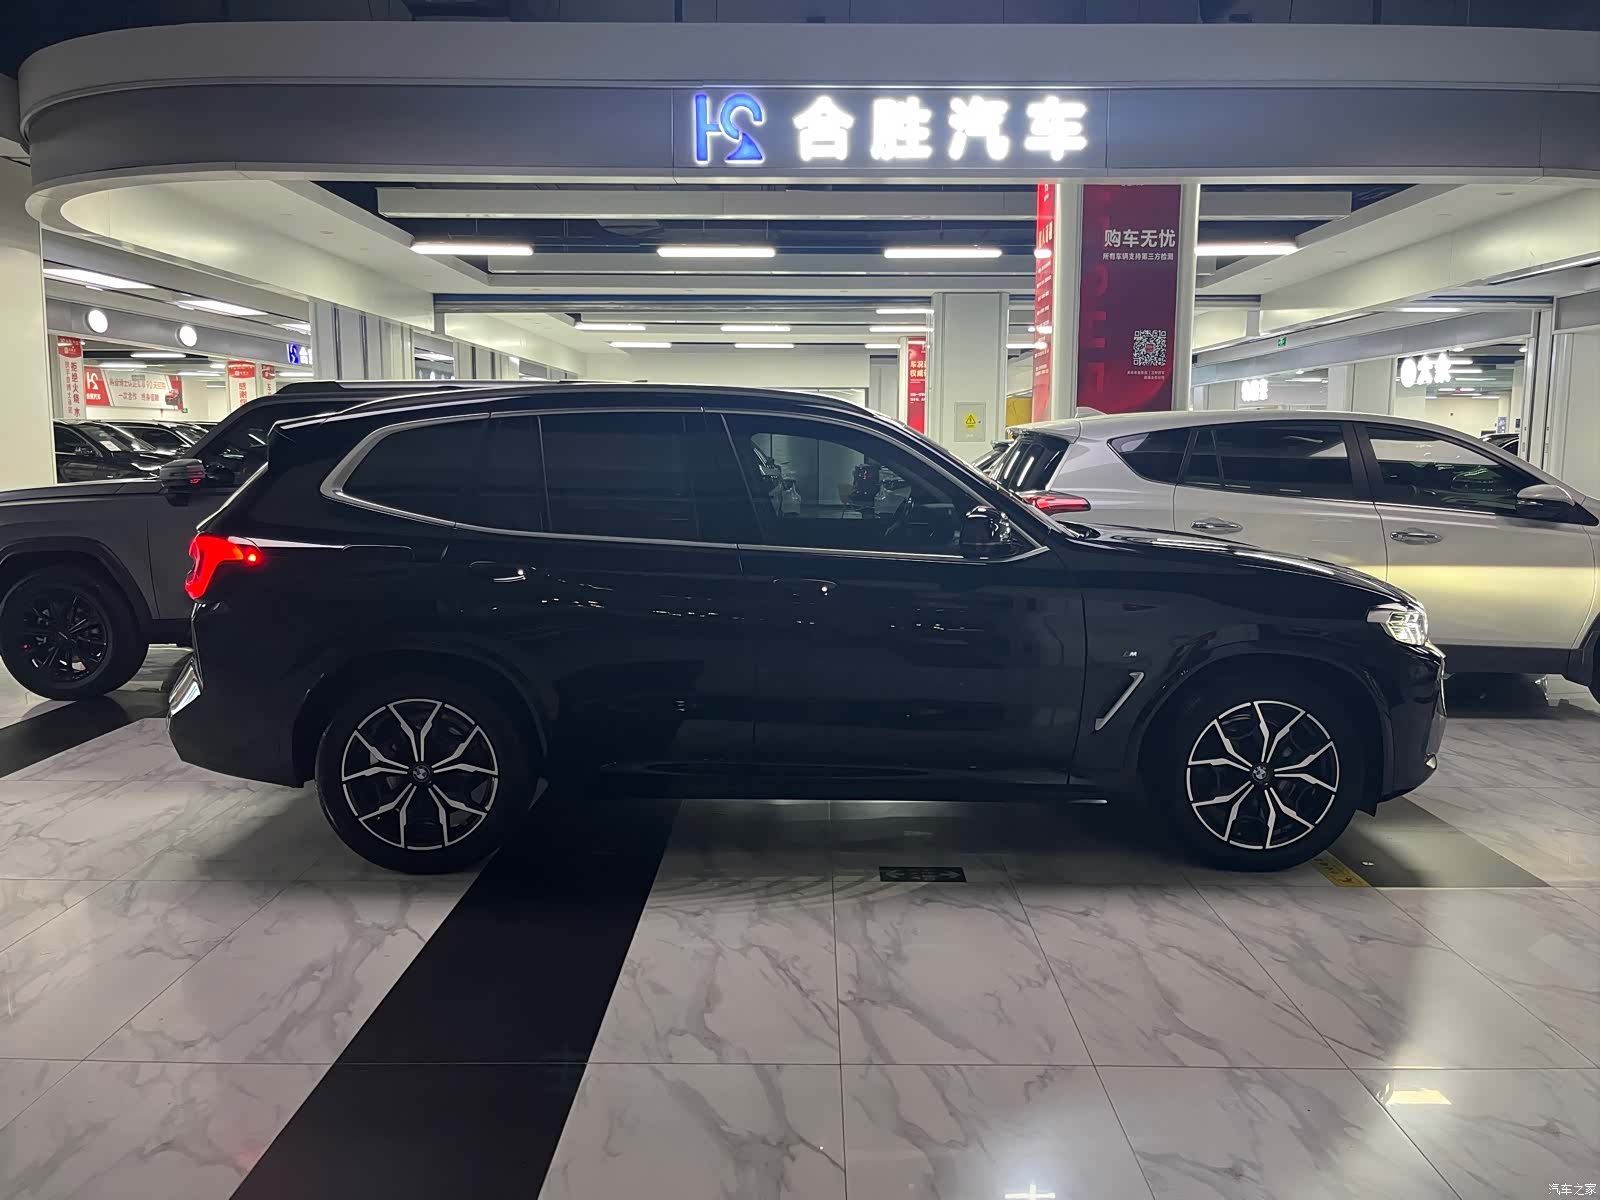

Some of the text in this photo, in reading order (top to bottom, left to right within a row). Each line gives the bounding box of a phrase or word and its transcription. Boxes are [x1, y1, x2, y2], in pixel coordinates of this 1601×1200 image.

[793, 95, 1087, 162] 合胜汽车
[1104, 228, 1176, 248] 购车无忧
[1102, 252, 1174, 261] 所有车辆支持第三方检测
